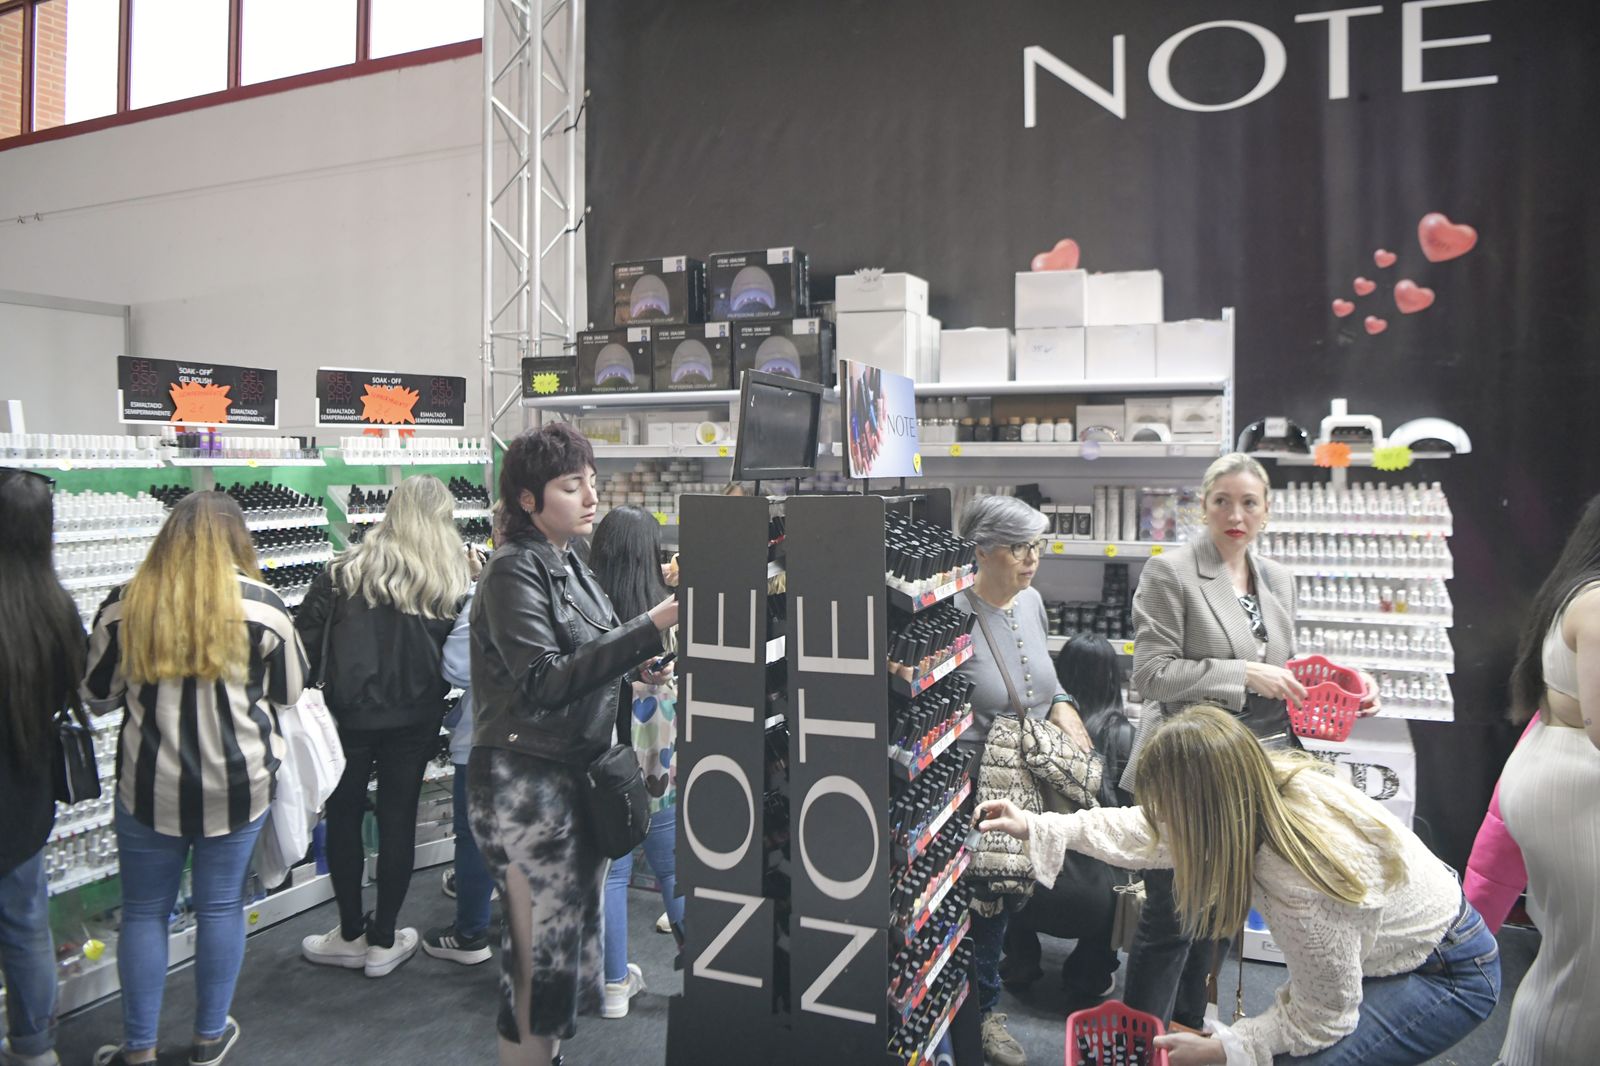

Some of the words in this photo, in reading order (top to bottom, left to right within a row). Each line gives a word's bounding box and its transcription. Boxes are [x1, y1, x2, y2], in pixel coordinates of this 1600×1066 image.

[1024, 0, 1498, 128] NOTE
[131, 360, 157, 373] GEL
[178, 367, 196, 375] SOAK
[199, 368, 212, 376] OFF
[131, 372, 159, 386] OSO
[191, 376, 213, 385] POLISH
[240, 370, 263, 383] GEL
[328, 372, 351, 384] GEL
[391, 377, 402, 385] OFF
[240, 382, 264, 394] OSO
[327, 383, 352, 394] OSO
[431, 377, 450, 389] GEL
[131, 385, 157, 398] PHY
[431, 388, 454, 399] OSO
[130, 401, 162, 409] ESMALTADO
[241, 393, 263, 405] PHY
[328, 393, 350, 405] PHY
[432, 398, 452, 408] PHY
[124, 408, 171, 417] SEMIPERMANENTE
[231, 408, 258, 416] ESMALTADO
[887, 414, 916, 438] NOTE
[683, 586, 766, 988] NOTE
[797, 595, 879, 1025] NOTE
